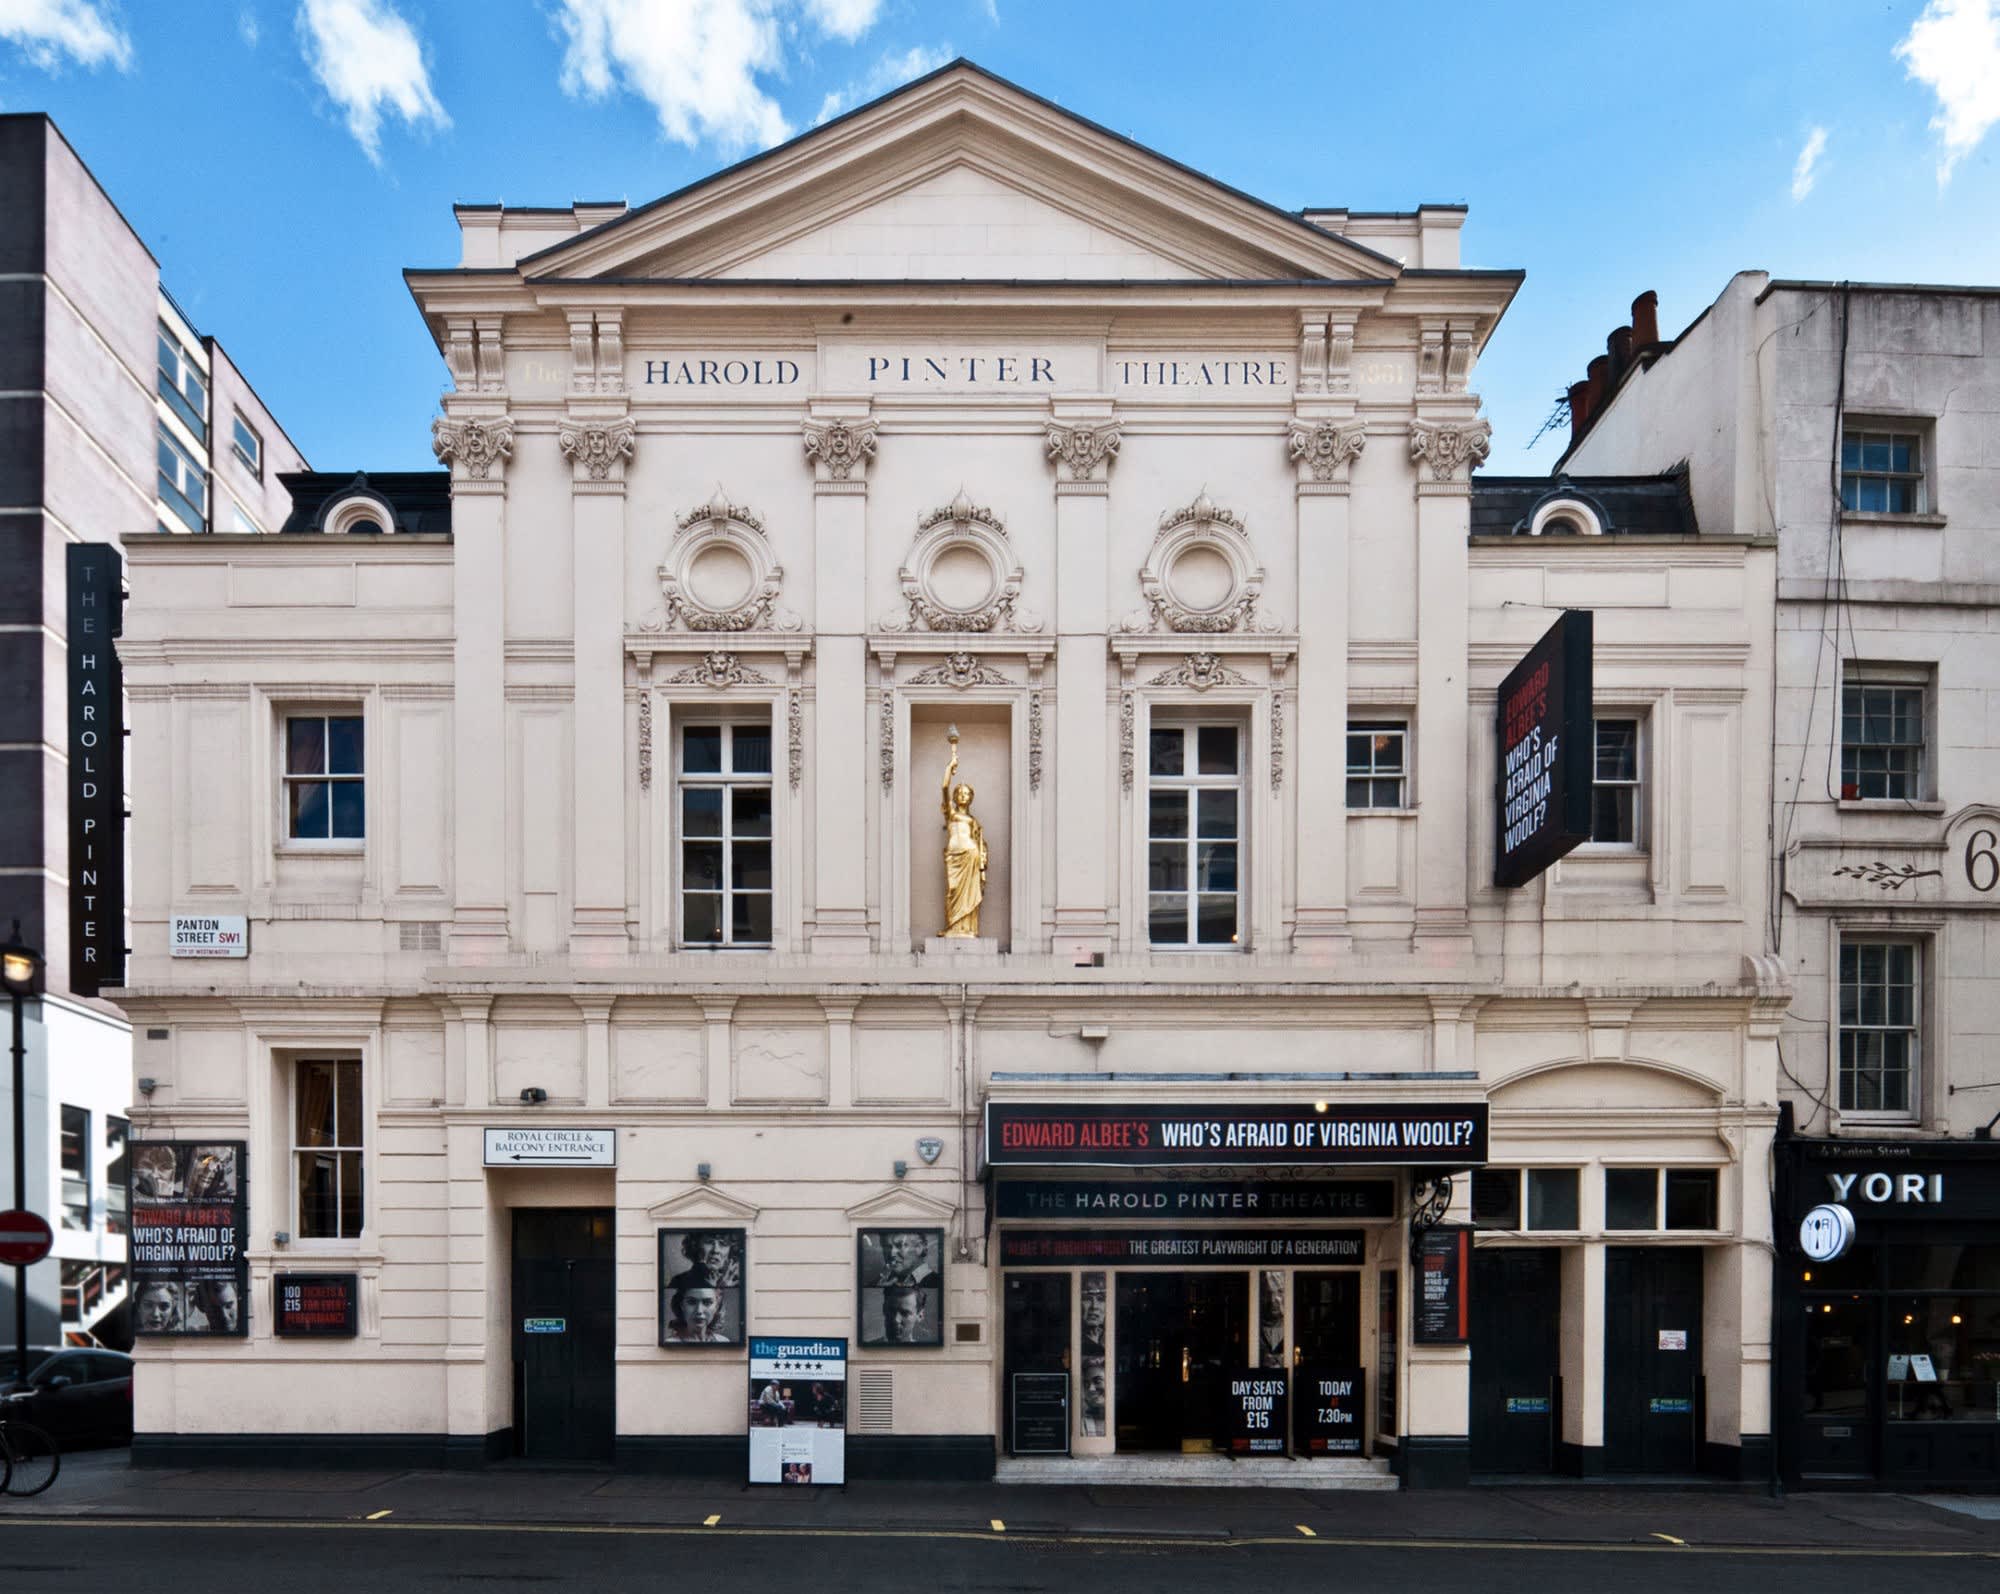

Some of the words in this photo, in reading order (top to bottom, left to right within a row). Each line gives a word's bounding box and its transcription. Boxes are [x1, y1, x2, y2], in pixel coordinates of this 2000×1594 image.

[644, 360, 800, 384] HAROLD
[868, 357, 1056, 382] PINTER
[1115, 361, 1288, 385] THEATRE
[82, 566, 96, 634] THE
[1506, 660, 1550, 724] EDWARD
[81, 654, 97, 798] HAROLD
[1506, 690, 1547, 749] ALBEE'S
[1505, 725, 1541, 777] WHO'S
[1505, 752, 1541, 804] AFRAID
[1544, 735, 1558, 768] OF
[1505, 771, 1551, 828] VIRGINIA
[1504, 800, 1547, 854] WOOLF?
[1965, 829, 2000, 892] 6
[83, 818, 97, 963] PINTER
[176, 919, 220, 931] PANTON
[176, 932, 215, 943] STREET
[219, 932, 241, 944] SW1
[507, 1132, 541, 1141] ROYAL
[545, 1132, 582, 1142] CIRCLE
[585, 1132, 593, 1142] &
[1002, 1122, 1076, 1147] EDWARD
[1080, 1121, 1150, 1147] ALBEE'S
[1161, 1122, 1222, 1148] WHO'S
[1225, 1122, 1288, 1147] AFRAID
[1293, 1122, 1315, 1147] OF
[1320, 1122, 1398, 1147] VIRGINIA
[1402, 1120, 1474, 1146] WOOLF?
[495, 1143, 547, 1152] BALCONY
[548, 1143, 606, 1153] ENTRANCE
[1877, 1145, 1911, 1157] Street
[1827, 1172, 1943, 1203] YORI
[1026, 1193, 1066, 1208] THE
[1076, 1193, 1168, 1208] HAROLD
[1178, 1193, 1259, 1208] PINTER
[1268, 1192, 1367, 1208] THEATRE
[133, 1208, 181, 1226] EDWARD
[184, 1208, 232, 1226] ALBEE'S
[133, 1227, 174, 1243] WHO'S
[176, 1227, 217, 1243] AFRAID
[220, 1227, 235, 1243] OF
[134, 1245, 186, 1261] VIRGINIA
[188, 1245, 236, 1261] WOOLF?
[1129, 1240, 1149, 1255] THE
[1150, 1240, 1200, 1255] GREATEST
[1202, 1240, 1267, 1255] PLAYWRIGHT
[1270, 1240, 1283, 1255] OF
[1285, 1240, 1294, 1255] A
[284, 1286, 301, 1298] 100
[284, 1299, 301, 1311] £15
[1231, 1381, 1252, 1395] DAY
[1253, 1381, 1284, 1395] SEATS
[1318, 1381, 1353, 1396] TODAY
[1242, 1396, 1273, 1410] FROM
[1246, 1411, 1269, 1428] £15
